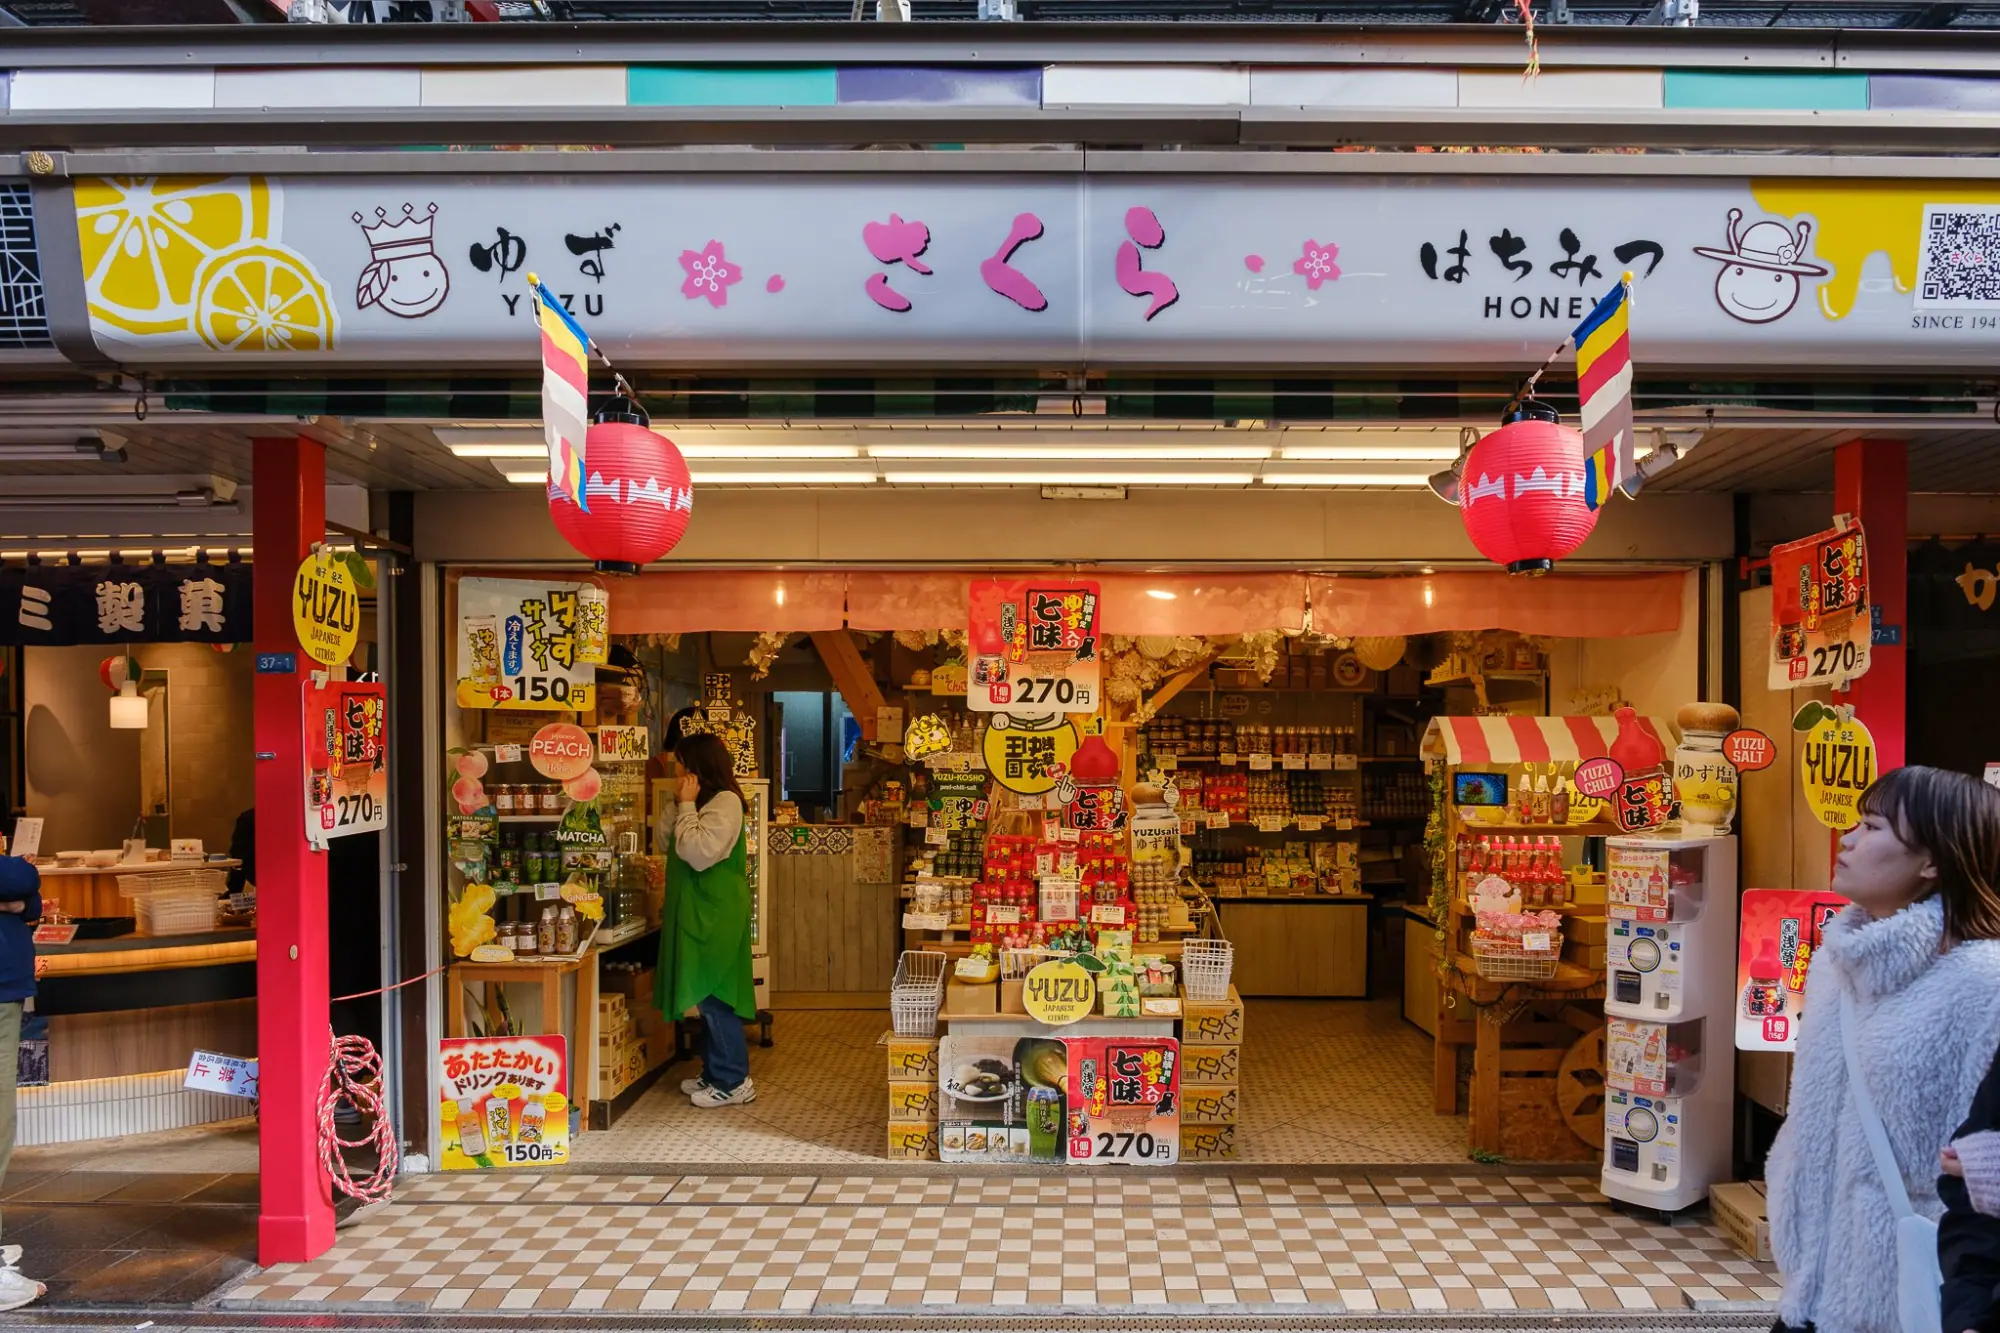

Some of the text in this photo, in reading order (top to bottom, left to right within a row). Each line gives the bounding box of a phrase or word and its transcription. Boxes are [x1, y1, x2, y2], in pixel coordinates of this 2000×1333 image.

[469, 222, 622, 284] ゆず
[862, 205, 1180, 321] さくら
[1420, 227, 1665, 287] はちみつ
[1951, 251, 1984, 264] さくら
[1911, 315, 2000, 330] SINCE 194
[1822, 546, 1845, 609] 七味
[298, 574, 355, 633] YUZU
[1032, 593, 1064, 648] 七味
[310, 626, 341, 646] JAPANESE
[520, 599, 550, 672] サイダー
[260, 656, 290, 669] 37-1
[314, 647, 336, 662] CITRUS
[1812, 640, 1865, 677] 270円
[492, 687, 511, 700] 1本
[514, 676, 586, 703] 150円
[992, 685, 1009, 695] 1個
[1016, 677, 1090, 704] 270円
[345, 697, 365, 762] 七味
[532, 739, 590, 757] PEACH
[1732, 737, 1766, 751] YUZU
[1732, 750, 1765, 764] SALT
[1806, 742, 1870, 790] YUZU
[932, 773, 985, 782] YUZU-KOSHO
[1579, 763, 1613, 783] YUZU
[1678, 764, 1734, 784] ゆず塩
[1583, 776, 1616, 796] CHILI
[1819, 790, 1853, 807] JAPANESE
[337, 793, 383, 827] 270円
[1076, 789, 1099, 829] 七味
[1623, 785, 1651, 827] 七味
[1824, 810, 1847, 824] CITRUS
[556, 830, 605, 844] MATCHA
[1132, 828, 1180, 837] YUZUsalt
[567, 892, 599, 902] GINGER
[1781, 935, 1796, 967] 浅草
[1790, 943, 1810, 989] みやげ
[1028, 978, 1089, 1003] YUZU
[1751, 987, 1766, 1014] 七味
[1043, 1003, 1075, 1012] JAPANESE
[1766, 1019, 1786, 1032] 1個
[444, 1048, 554, 1079] あたたかい
[1111, 1049, 1143, 1103] 七味
[454, 1071, 546, 1096] ドリンクあります
[1091, 1078, 1107, 1116] みやげ
[1073, 1140, 1089, 1151] 1個
[1096, 1132, 1170, 1159] 270円
